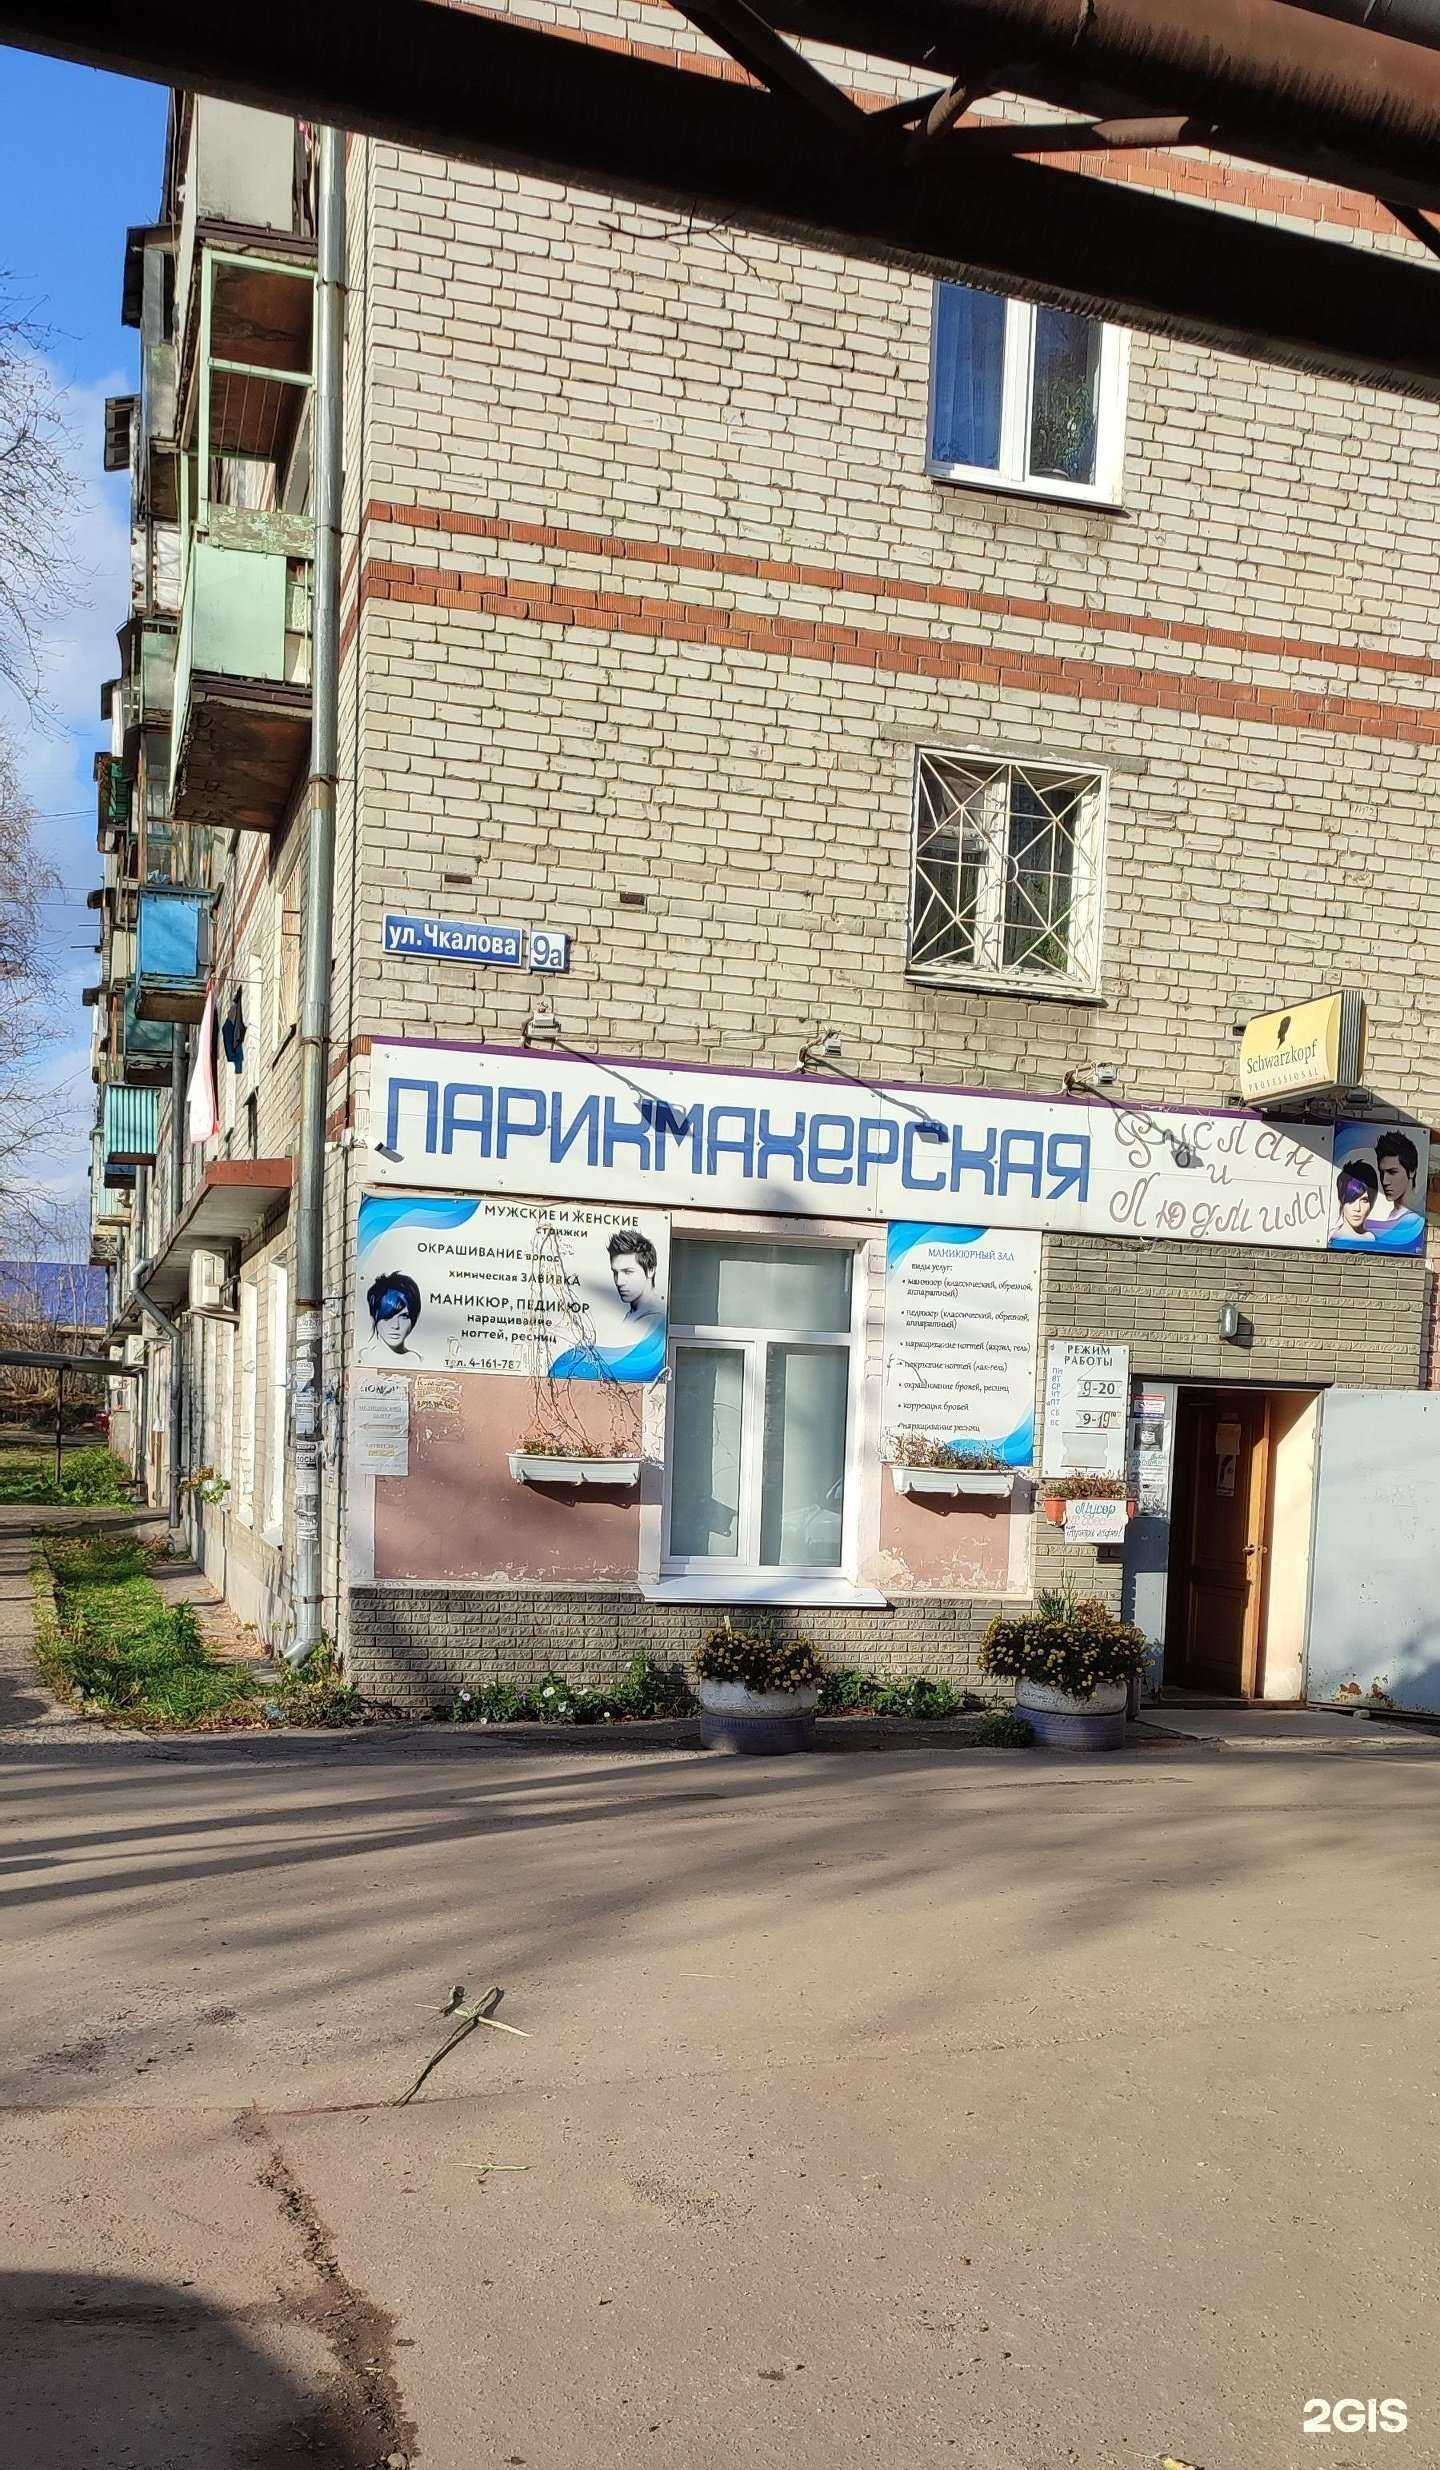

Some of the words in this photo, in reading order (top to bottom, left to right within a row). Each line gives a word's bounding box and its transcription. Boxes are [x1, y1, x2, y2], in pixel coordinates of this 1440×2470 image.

[388, 924, 422, 949] ул.
[424, 923, 516, 956] Чкалова
[533, 935, 563, 967] 9а
[1246, 1038, 1318, 1074] Schwarzkopf
[1248, 1068, 1319, 1092] PROFESSIONAL
[1109, 1172, 1326, 1239] Людмила
[484, 1204, 556, 1221] МУЖСКИЕ
[559, 1210, 569, 1222] И
[572, 1211, 639, 1227] ЖЕНСКИЕ
[536, 1226, 588, 1238] стрижки
[417, 1242, 523, 1260] ОКРАШИВАНИЕ
[525, 1252, 560, 1263] волос
[928, 1248, 996, 1260] МАНИКЮРНЫЙ
[998, 1251, 1015, 1261] ЗАЛ
[449, 1270, 518, 1282] химическая
[521, 1272, 581, 1286] ЗАВИВКА
[430, 1293, 513, 1311] МАНИКЮР,
[517, 1298, 590, 1313] ПЕДИКЮР
[467, 1314, 553, 1327] наращивание
[461, 1328, 508, 1342] ногтей,
[511, 1333, 557, 1344] ресниц
[1067, 1344, 1111, 1356] РЕЖИМ
[1064, 1355, 1113, 1367] РАБОТЫ
[1082, 1381, 1115, 1397] 9-20
